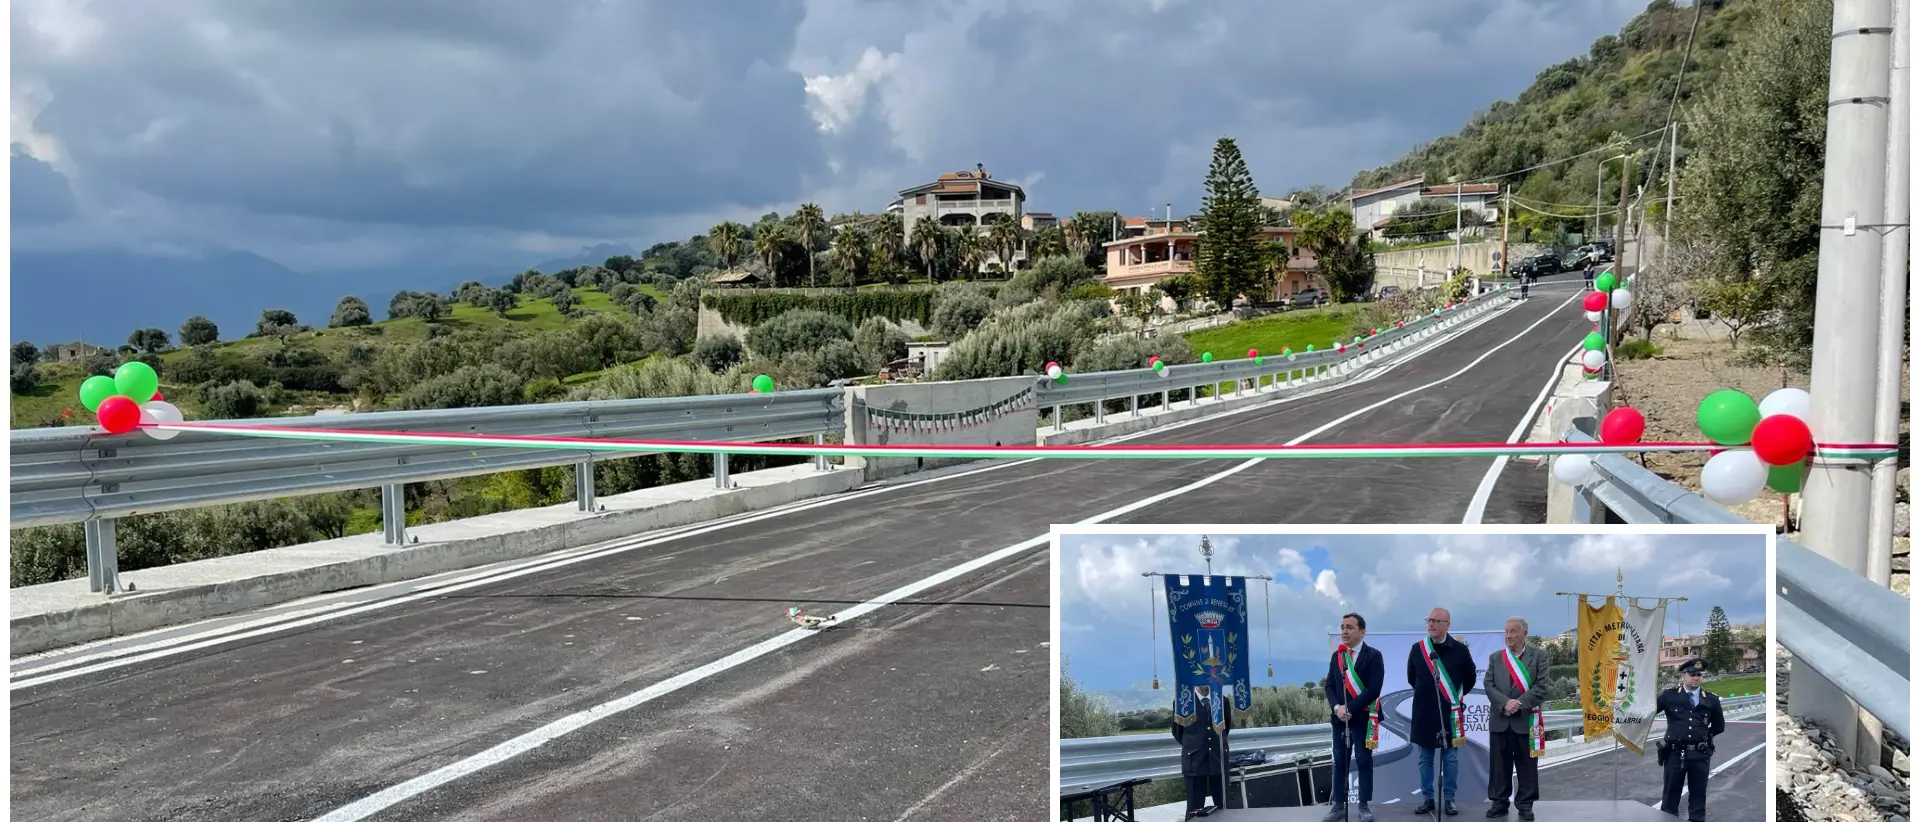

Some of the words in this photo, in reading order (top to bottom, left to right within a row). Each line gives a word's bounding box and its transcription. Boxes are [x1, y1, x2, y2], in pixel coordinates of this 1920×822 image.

[1179, 598, 1204, 612] COMUNE
[1617, 633, 1626, 641] DI
[1467, 704, 1490, 714] CAR
[1463, 723, 1489, 732] OVAL
